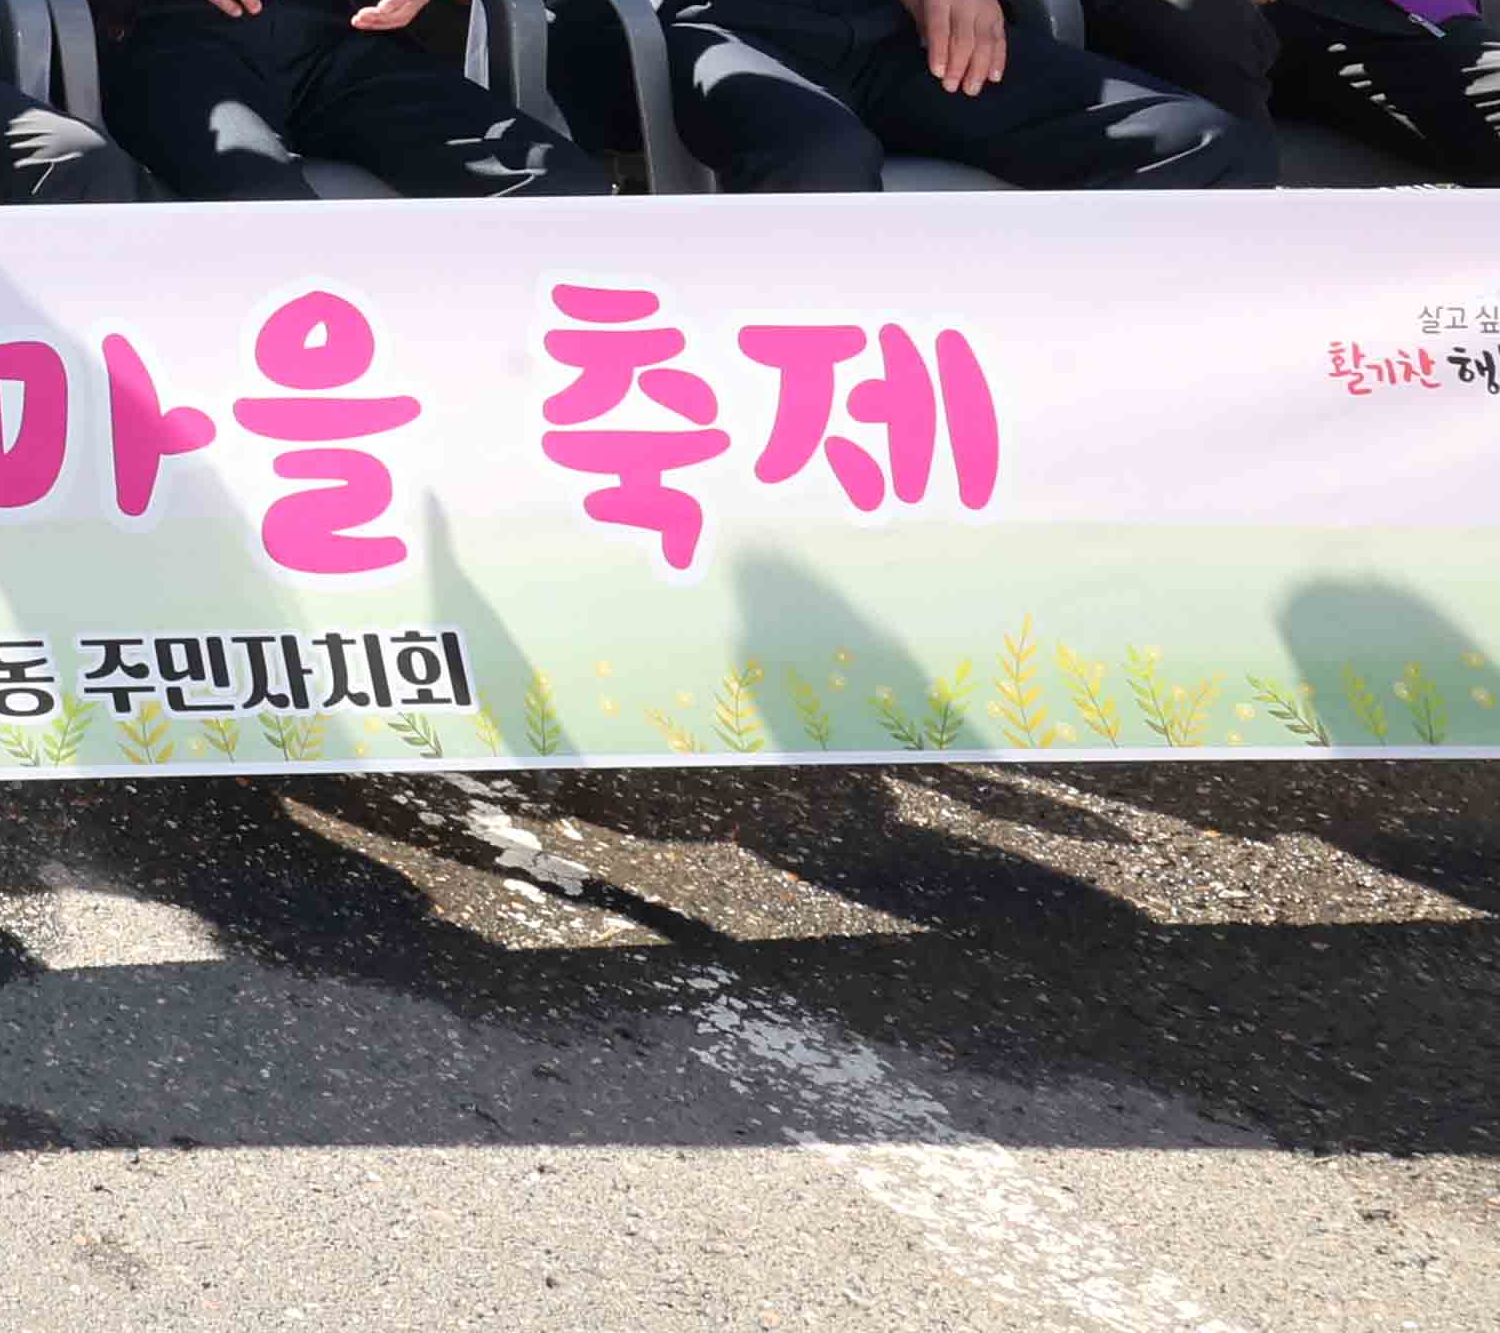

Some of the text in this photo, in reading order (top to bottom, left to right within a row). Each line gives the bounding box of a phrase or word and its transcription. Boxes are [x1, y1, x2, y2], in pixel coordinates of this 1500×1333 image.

[1417, 305, 1468, 334] 살고
[1328, 340, 1442, 396] 활기찬
[541, 283, 1000, 573] 축제
[84, 629, 473, 716] 주민자치회
